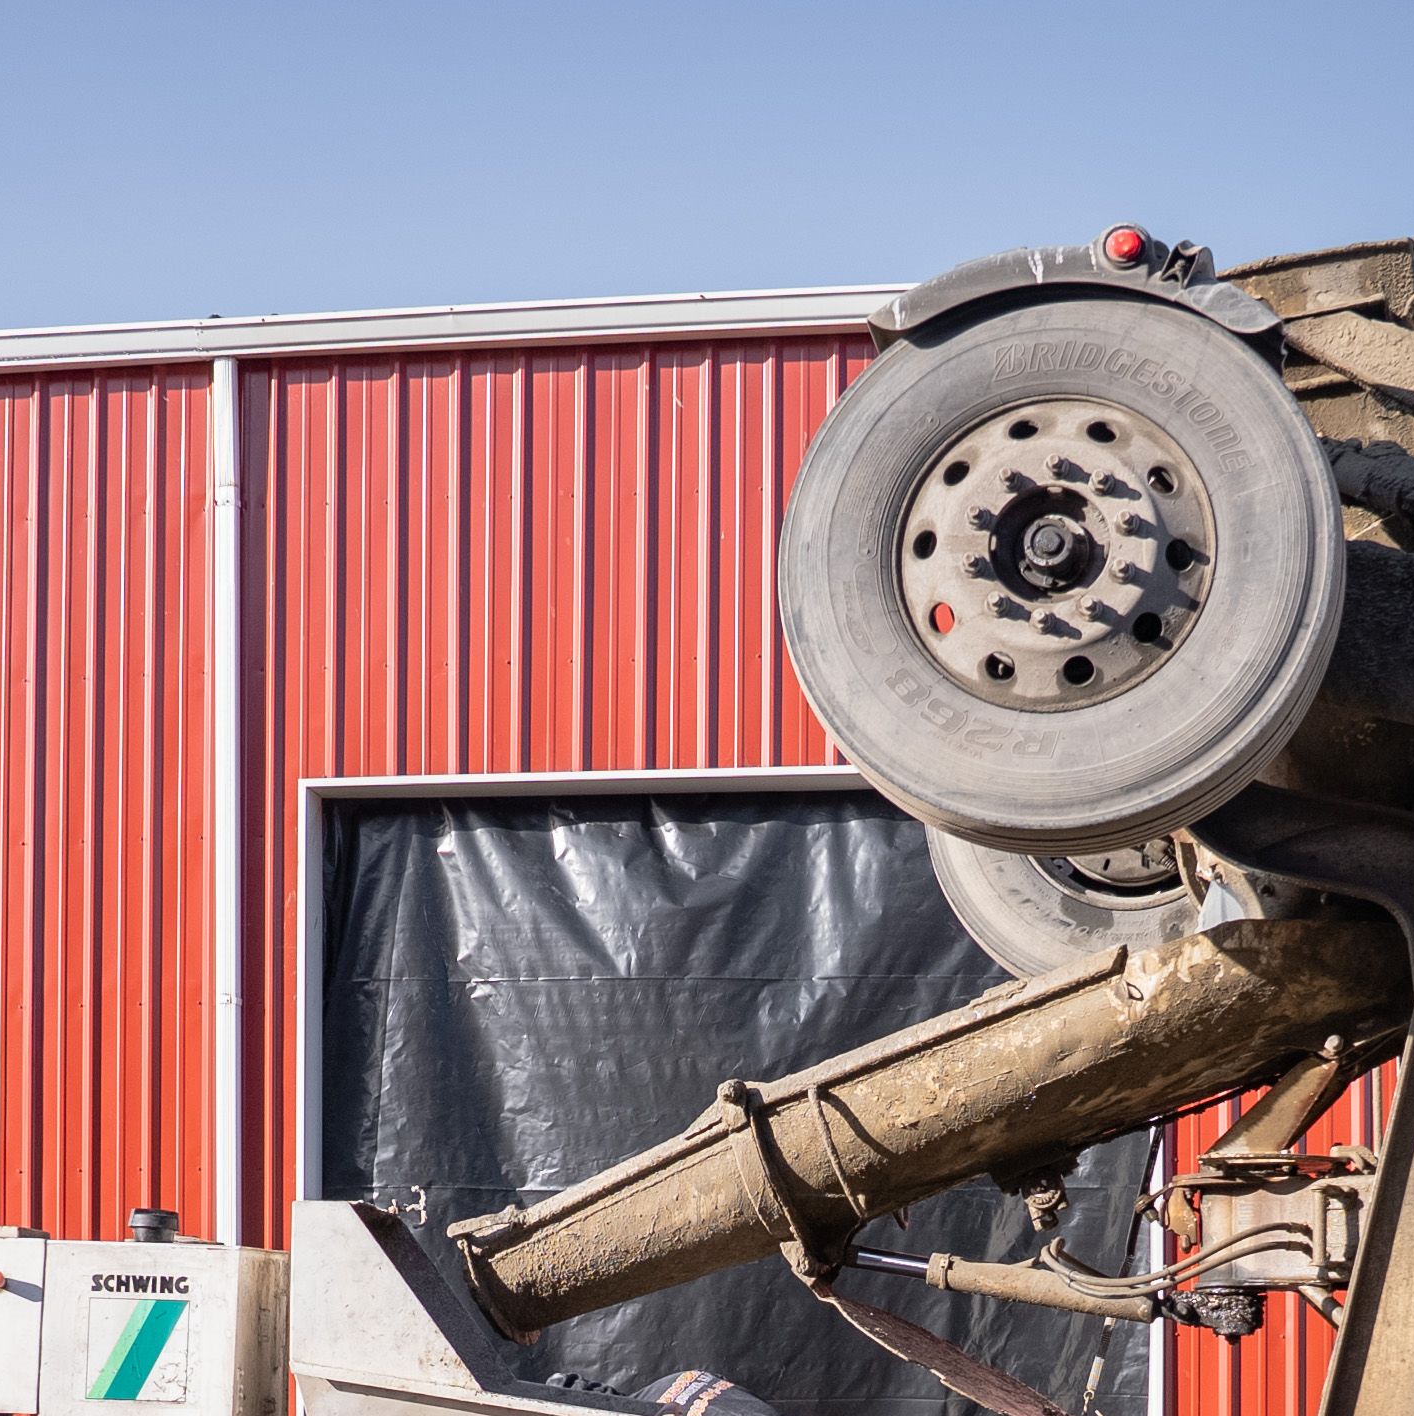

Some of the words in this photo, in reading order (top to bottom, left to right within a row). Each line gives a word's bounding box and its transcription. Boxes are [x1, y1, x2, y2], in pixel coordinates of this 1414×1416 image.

[993, 339, 1256, 473] BRIDGESTONE
[883, 668, 1060, 759] R268
[91, 1274, 189, 1294] SCHWING
